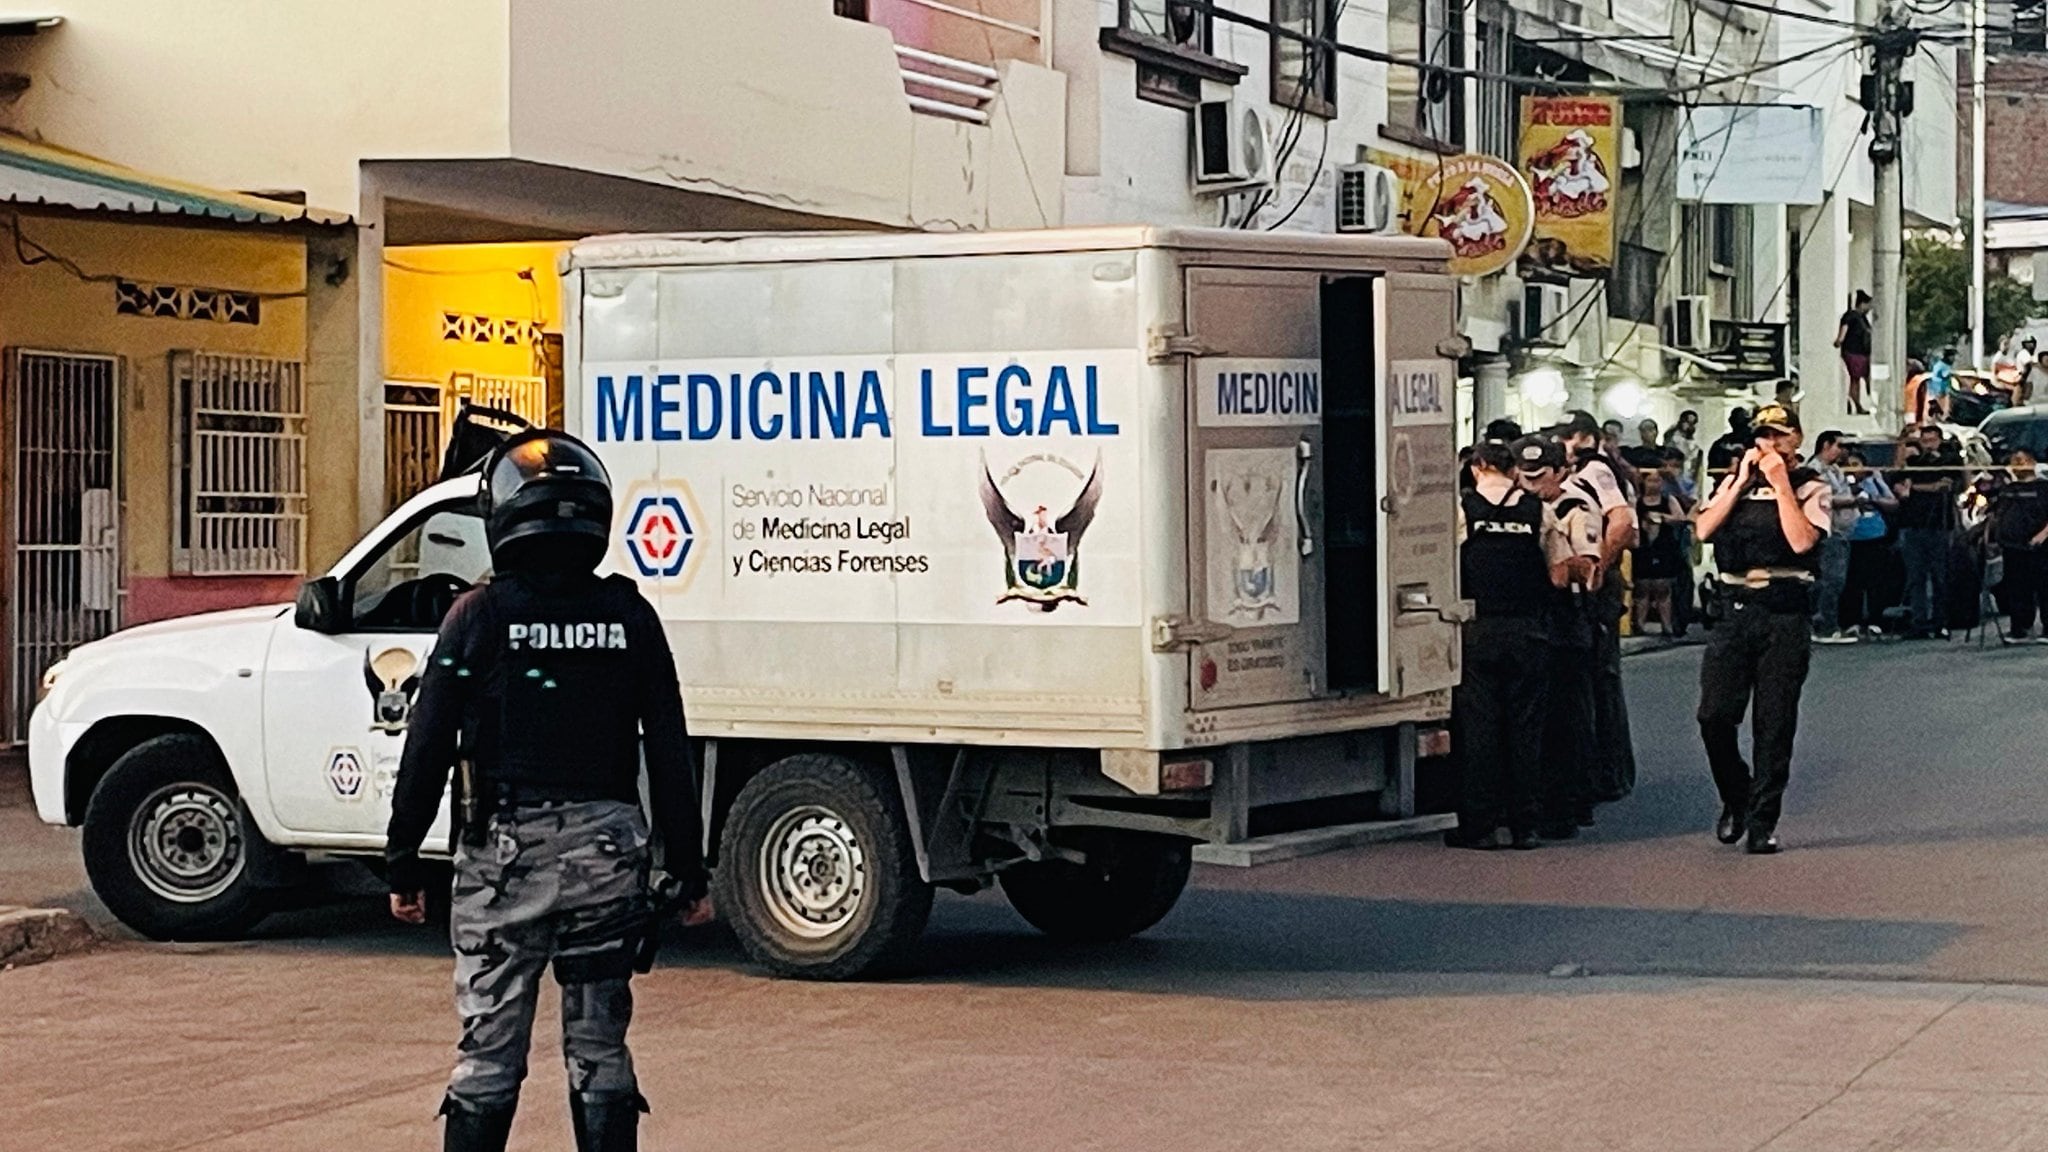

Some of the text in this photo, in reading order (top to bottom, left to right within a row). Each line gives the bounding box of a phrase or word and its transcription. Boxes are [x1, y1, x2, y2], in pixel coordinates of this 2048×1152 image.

[597, 364, 1120, 442] MEDICINA LEGAL
[1217, 372, 1319, 416] MEDICIN
[1403, 373, 1443, 414] LEGAL
[733, 483, 888, 507] Servicio Nacional
[733, 515, 911, 544] de Medicina Legal
[733, 549, 929, 577] y Ciencias Forenses
[509, 623, 628, 650] POLICIA
